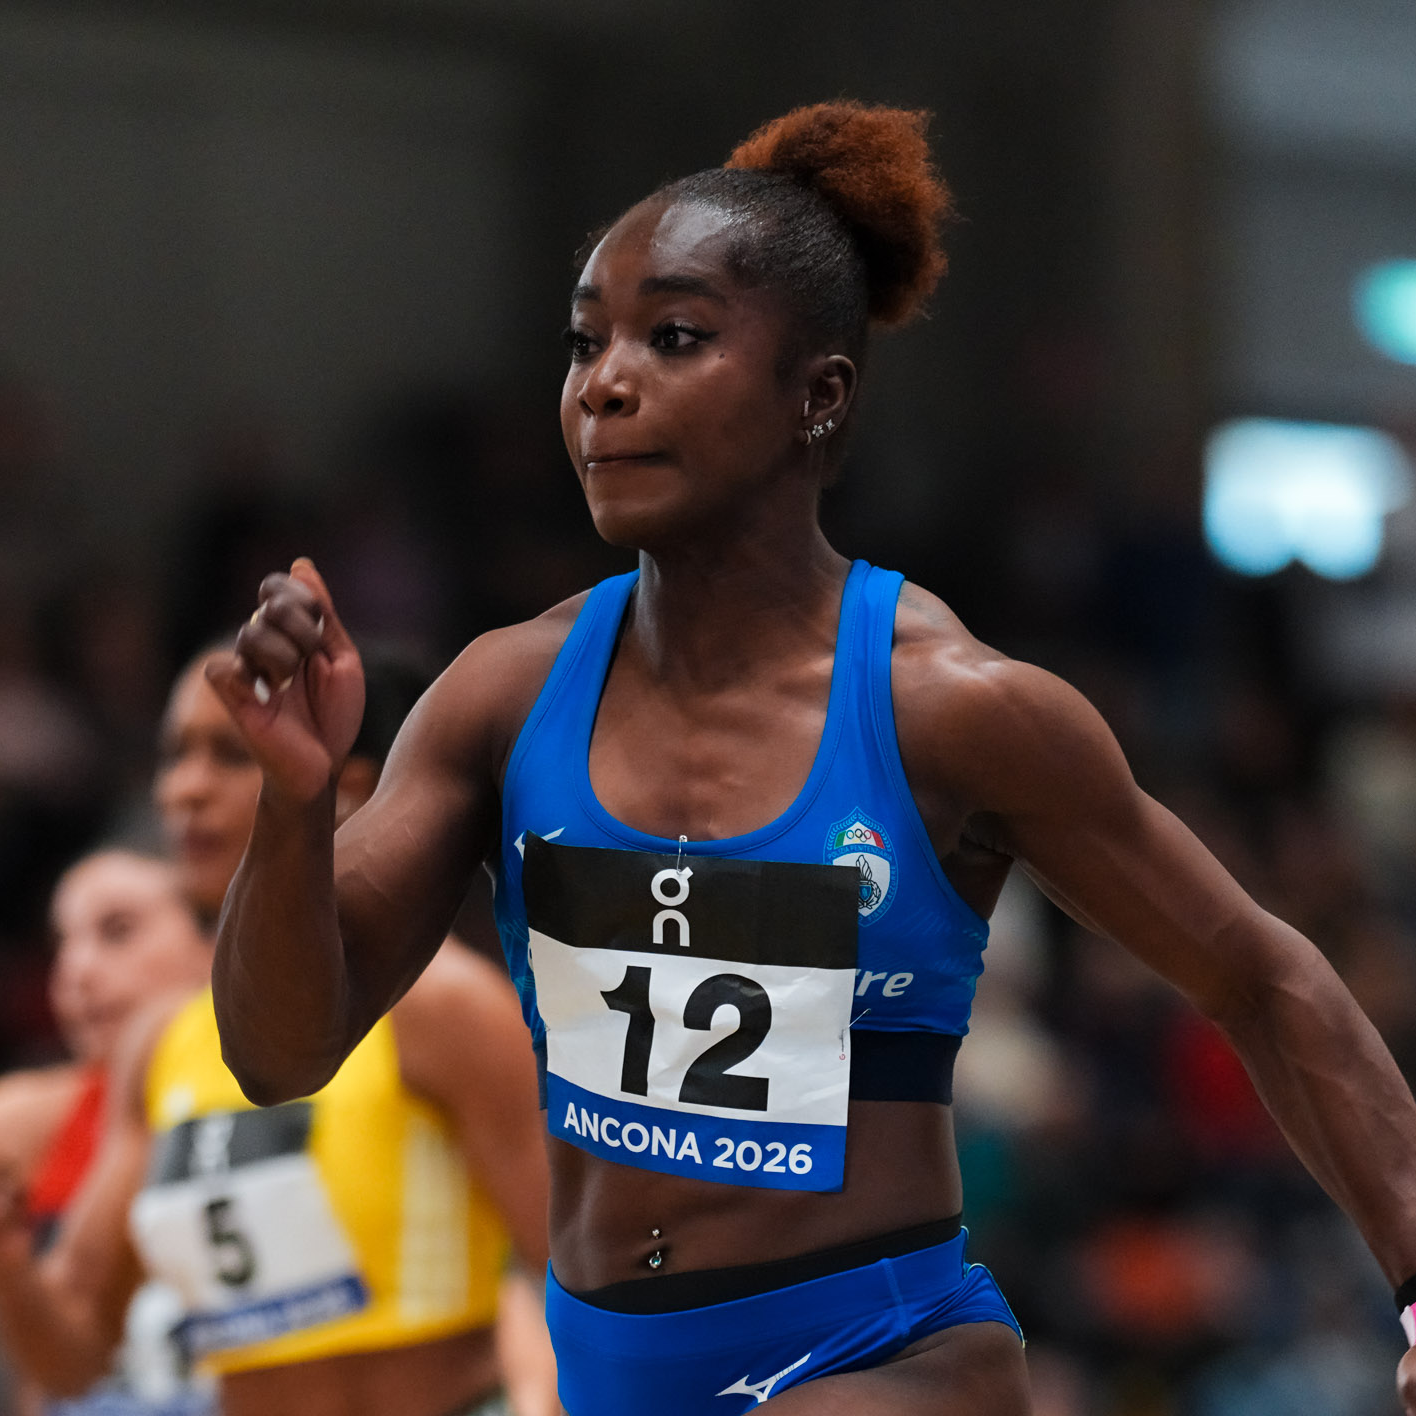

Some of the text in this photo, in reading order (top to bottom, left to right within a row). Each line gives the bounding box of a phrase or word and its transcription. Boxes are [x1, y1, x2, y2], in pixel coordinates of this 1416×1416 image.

[600, 965, 772, 1112] 12
[563, 1102, 813, 1175] ANCONA 2026
[204, 1198, 256, 1288] 5
